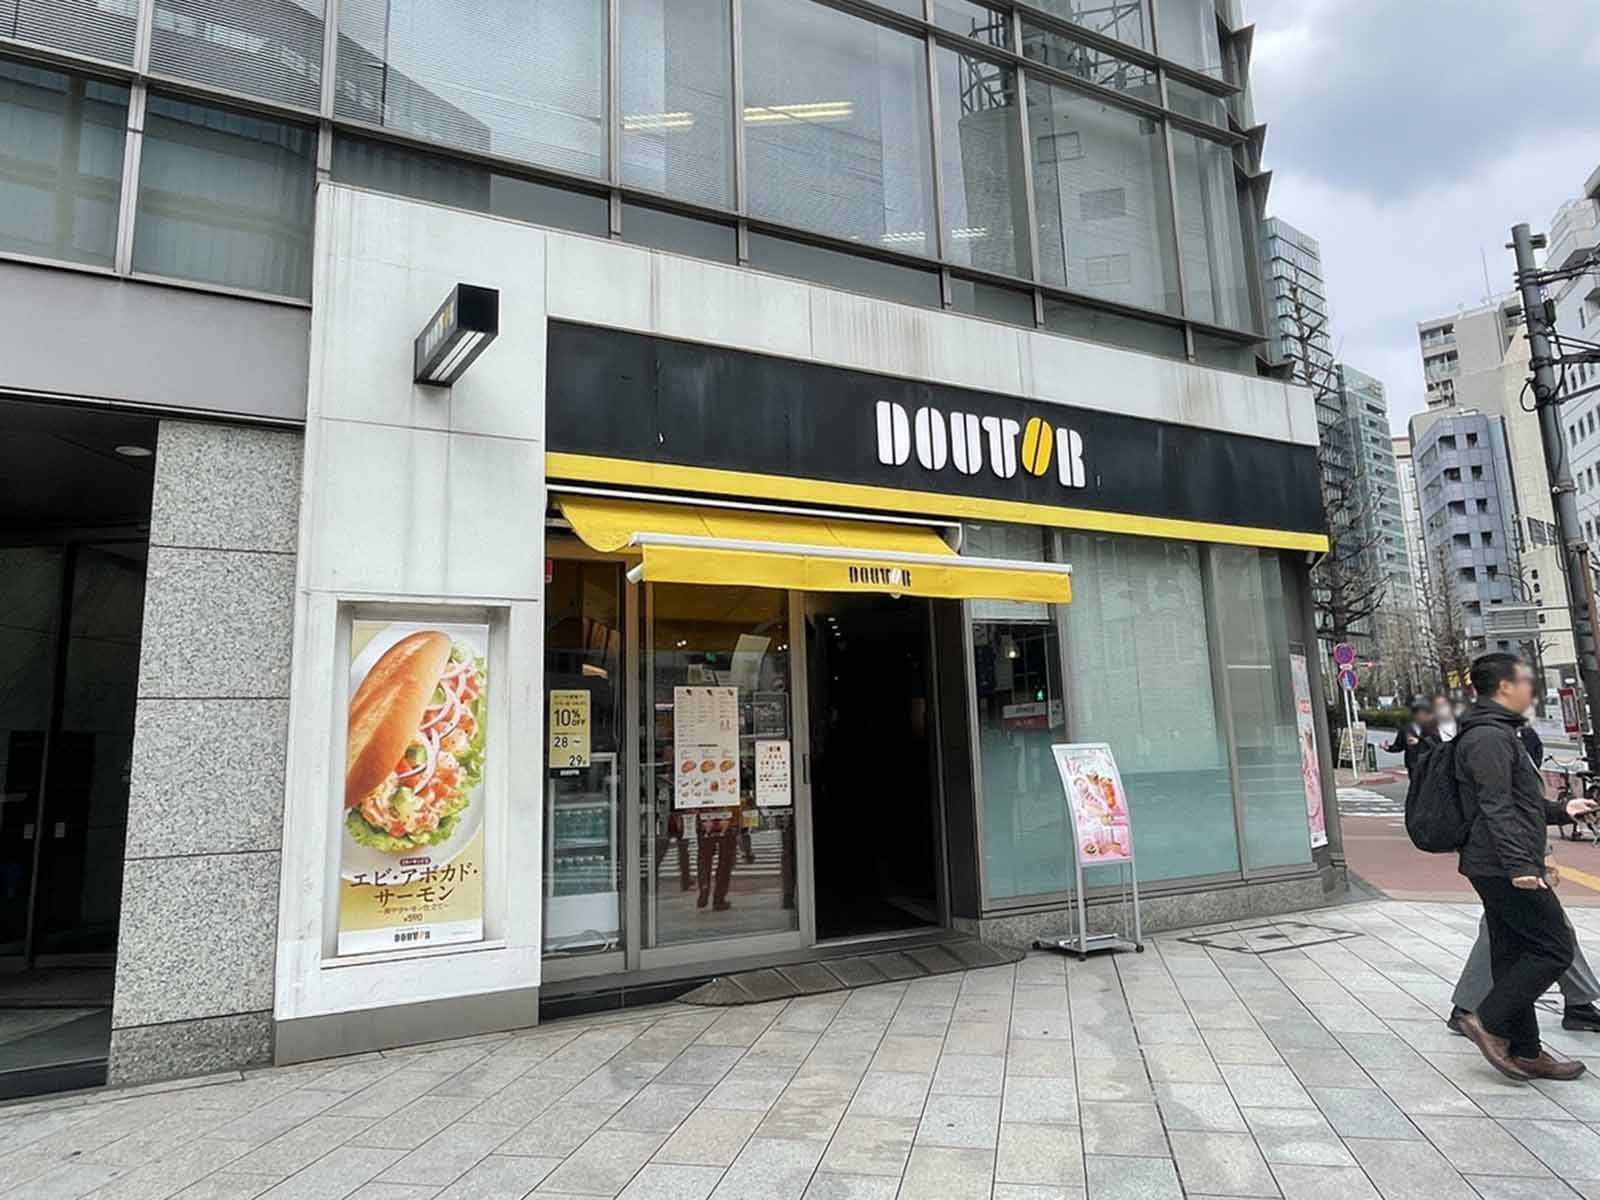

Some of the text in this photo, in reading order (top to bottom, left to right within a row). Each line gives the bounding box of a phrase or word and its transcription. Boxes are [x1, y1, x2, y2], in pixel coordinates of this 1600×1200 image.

[876, 400, 1086, 488] DOUTOR
[849, 566, 911, 587] DOUTOR
[374, 885, 456, 907] サーモン
